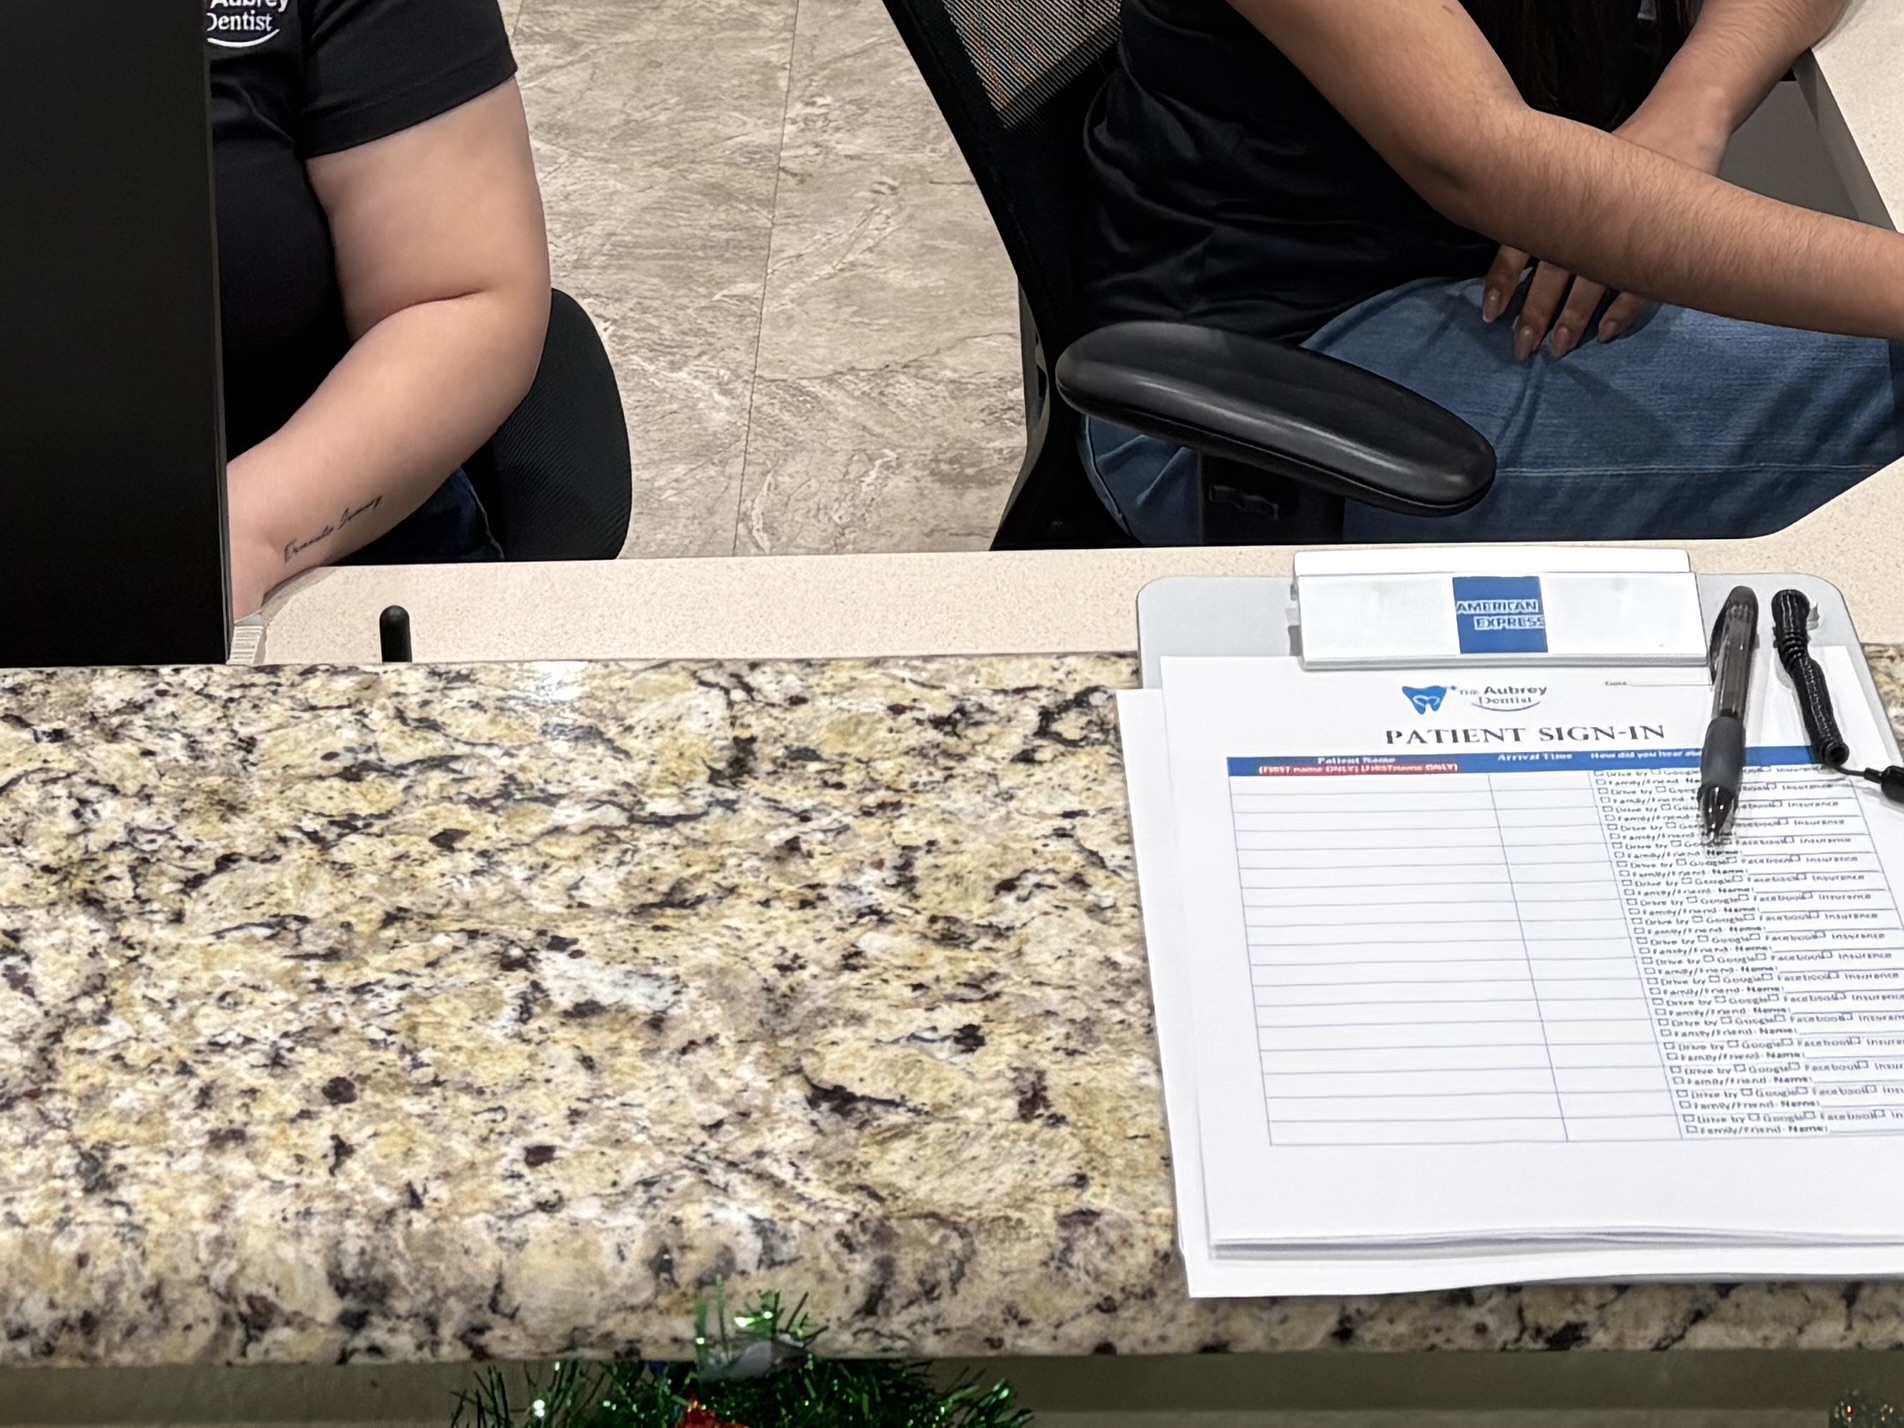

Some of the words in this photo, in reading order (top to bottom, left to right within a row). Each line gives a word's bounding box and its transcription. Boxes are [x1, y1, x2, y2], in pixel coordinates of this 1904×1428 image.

[1456, 599, 1538, 614] AMERICAN
[1483, 686, 1547, 696] Aubrey
[1386, 727, 1526, 745] PATIENT
[1538, 725, 1666, 742] SIGN-IN
[1497, 753, 1540, 761] Arrival
